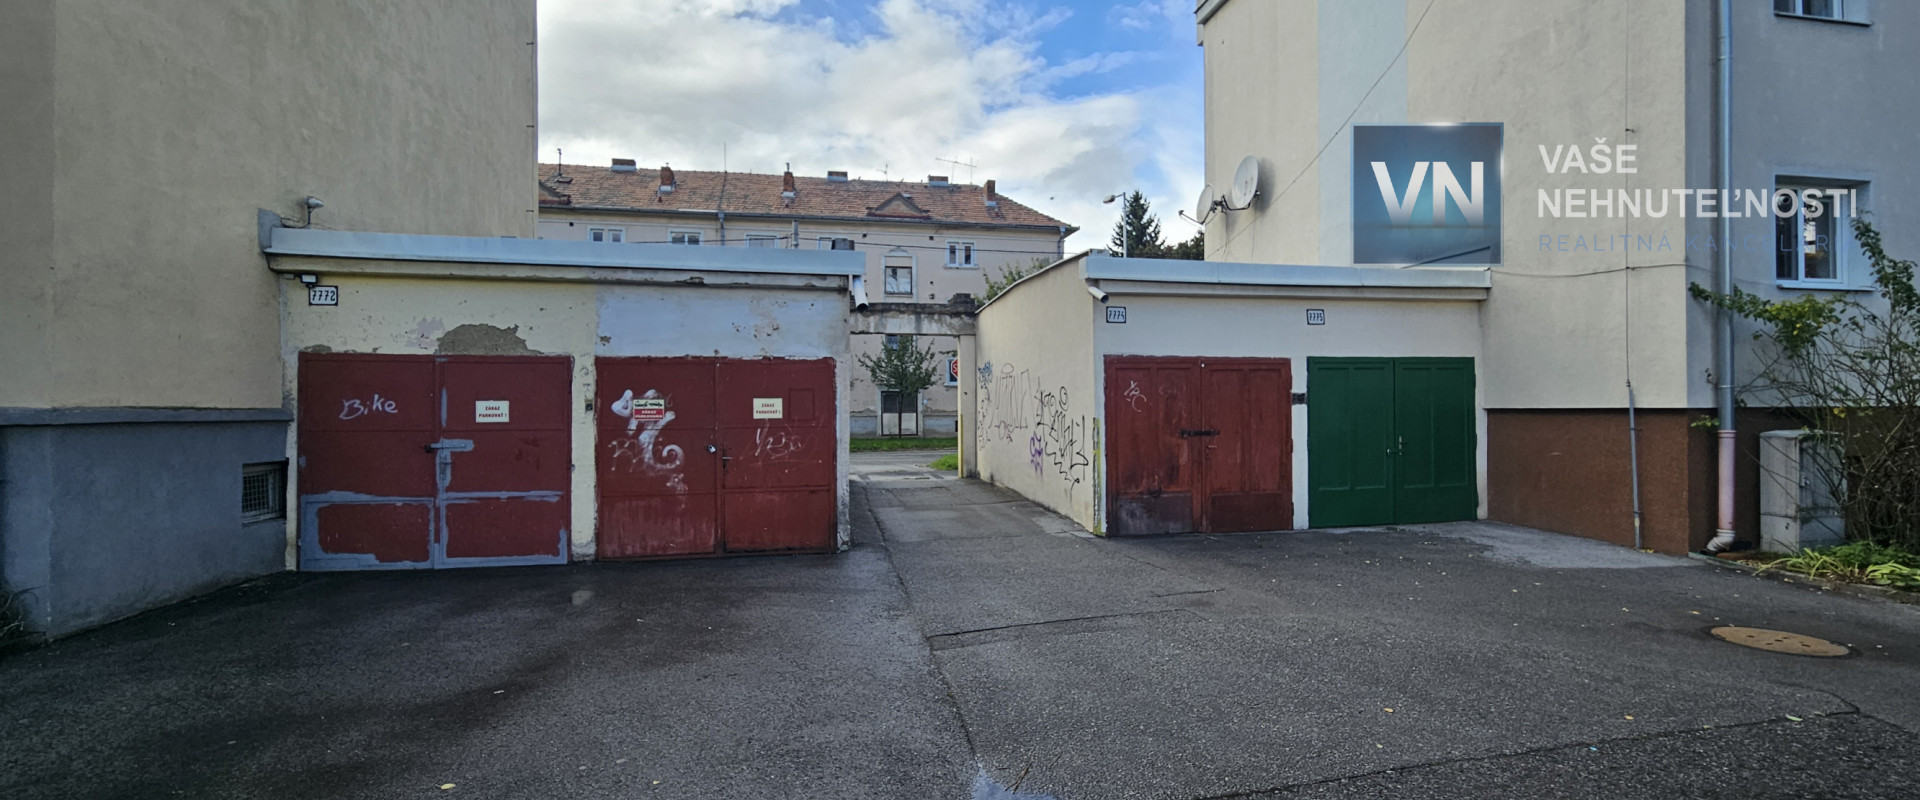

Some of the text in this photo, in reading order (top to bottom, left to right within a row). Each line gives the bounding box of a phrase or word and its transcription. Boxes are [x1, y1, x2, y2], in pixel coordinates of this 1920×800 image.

[311, 289, 336, 302] 7772
[1308, 312, 1323, 322] 7775
[339, 393, 399, 420] Bike
